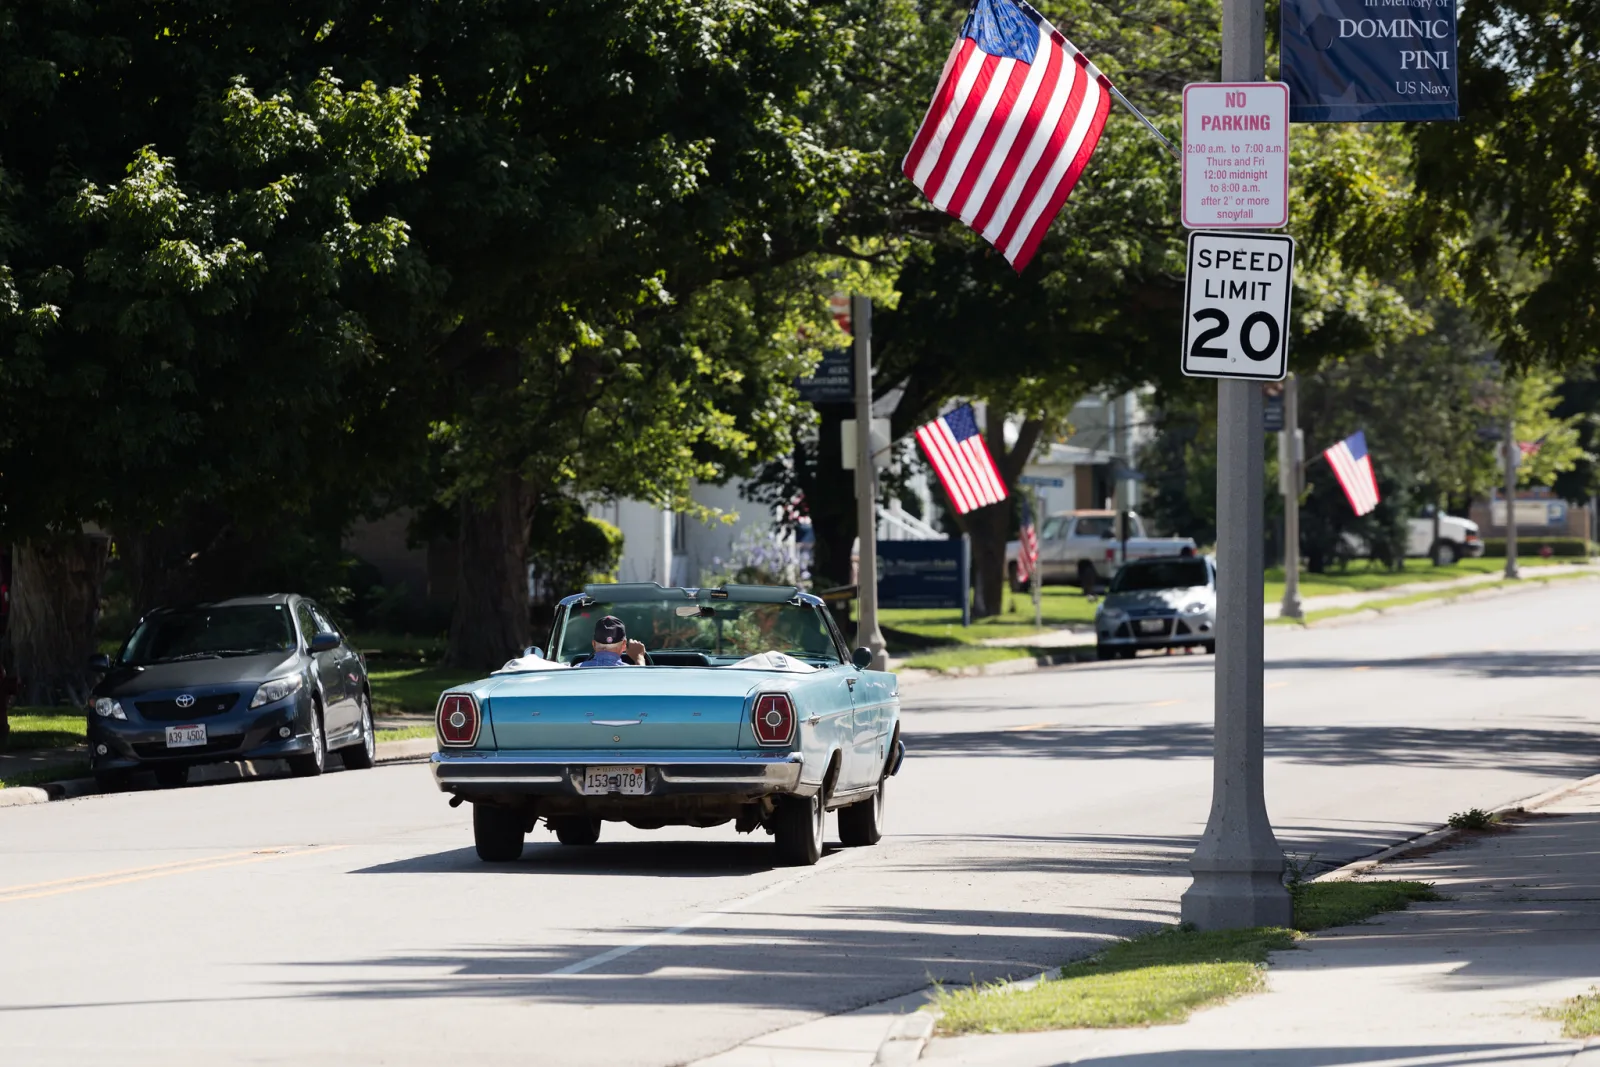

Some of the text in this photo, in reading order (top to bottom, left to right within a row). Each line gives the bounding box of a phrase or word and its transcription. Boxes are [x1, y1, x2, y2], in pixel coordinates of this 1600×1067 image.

[1337, 18, 1449, 39] DOMINIC
[1400, 50, 1450, 70] PINI
[1396, 81, 1450, 97] US Navy
[1225, 91, 1247, 108] NO
[1201, 114, 1271, 131] PARKING
[1187, 143, 1284, 154] 2:00 a.m. to 7:00 a.m.
[1206, 156, 1265, 166] Thurs and Fri
[1204, 169, 1268, 182] 12:00 midnight
[1210, 183, 1261, 192] to 8:00 a.m.
[1201, 195, 1221, 206] after
[1235, 197, 1245, 205] or
[1247, 197, 1269, 205] more
[1217, 208, 1254, 219] snowfall
[1197, 249, 1283, 272] SPEED
[1205, 278, 1272, 301] LIMIT
[1190, 307, 1280, 362] 20
[168, 731, 182, 744] A39
